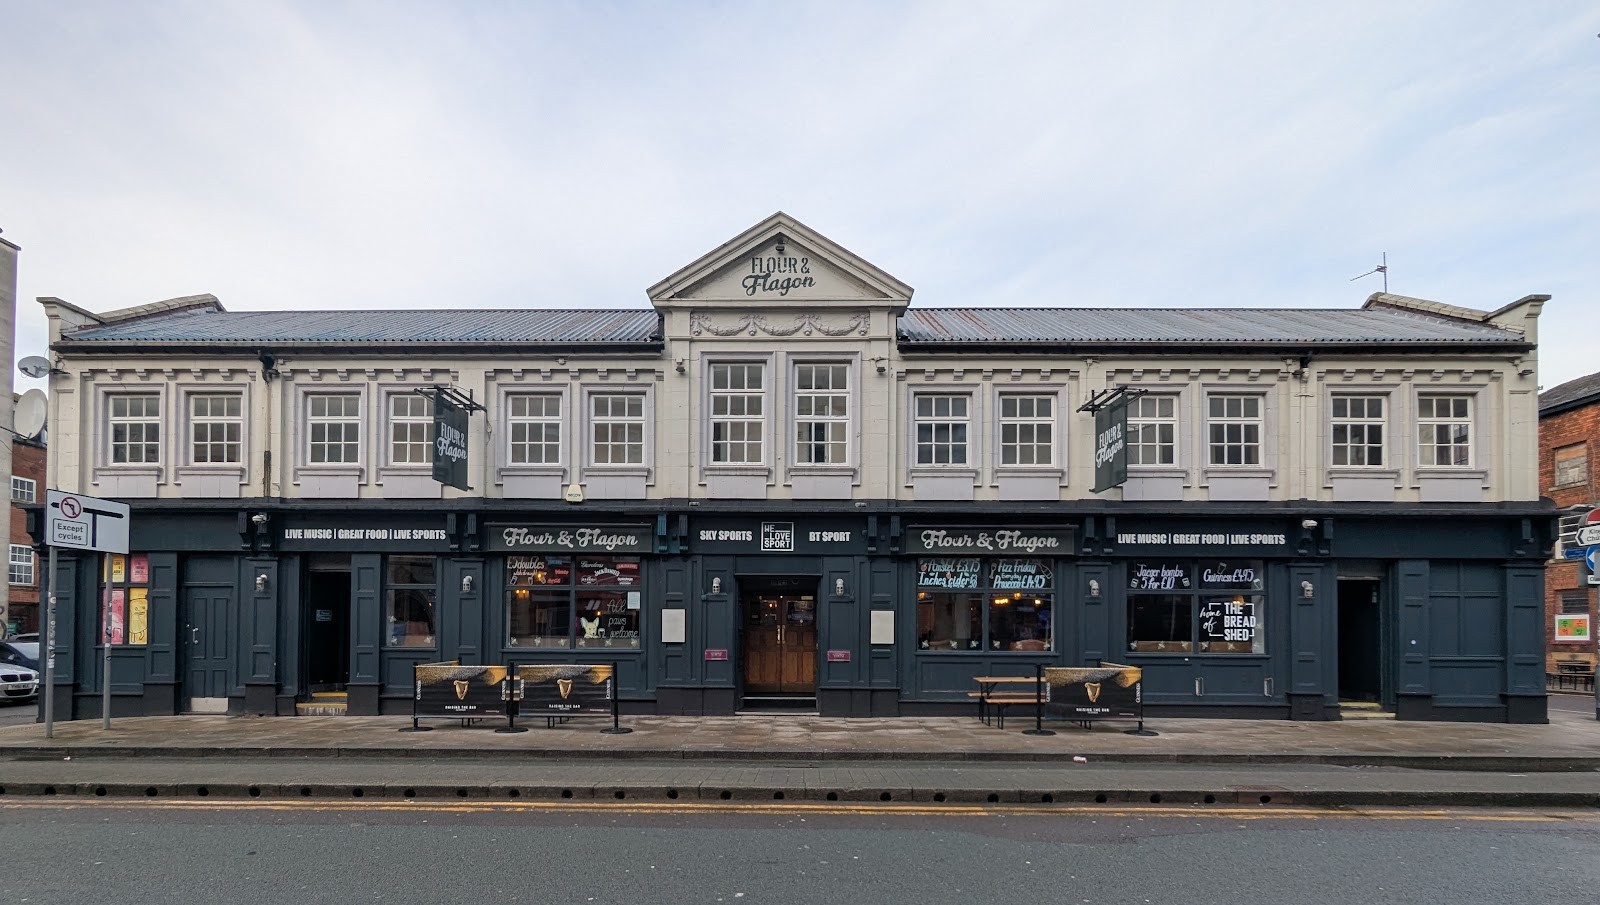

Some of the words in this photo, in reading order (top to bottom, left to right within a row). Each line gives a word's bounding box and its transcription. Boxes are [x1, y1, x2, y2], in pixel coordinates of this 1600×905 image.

[751, 257, 797, 273] FLOUR
[800, 257, 810, 274] &
[742, 272, 816, 296] Flagon
[441, 422, 461, 446] FLOUR
[460, 432, 465, 448] &
[1099, 425, 1117, 449] FLOUR
[1116, 422, 1122, 439] &
[437, 436, 467, 462] Flagon
[1096, 439, 1123, 468] Flagon
[57, 523, 83, 533] Except
[285, 529, 302, 539] LIVE
[304, 529, 332, 539] MUSIC
[338, 529, 364, 539] GREAT
[365, 530, 387, 539] FOOD
[394, 530, 411, 539] LIVE
[413, 530, 446, 540] SPORTS
[764, 524, 775, 533] WE
[58, 532, 82, 541] cycles
[503, 528, 555, 547] Flour
[557, 530, 574, 548] &
[575, 528, 638, 551] Flagon
[700, 530, 717, 541] SKY
[718, 530, 753, 541] SPORTS
[769, 532, 790, 540] LOVE
[809, 531, 821, 541] BT
[822, 531, 851, 542] SPORT
[920, 529, 974, 549] Flour
[976, 532, 994, 550] &
[995, 530, 1060, 552] Flagon
[1117, 533, 1137, 544] LIVE
[1138, 533, 1167, 544] MUSIC
[1173, 534, 1200, 544] GREAT
[1201, 534, 1225, 545] FOOD
[1231, 534, 1249, 545] LIVE
[1250, 534, 1286, 545] SPORTS
[764, 540, 790, 548] SPORT
[518, 556, 545, 569] doubles
[927, 559, 956, 572] Amstel
[997, 559, 1012, 572] Fizz
[1013, 559, 1037, 574] Friday
[1136, 563, 1160, 577] Jaeger
[1161, 563, 1184, 577] bombs
[1203, 568, 1232, 582] Guinness
[918, 571, 946, 586] Inches
[947, 572, 970, 586] cider
[1140, 577, 1148, 589] 5
[1148, 577, 1160, 589] for
[1160, 577, 1175, 589] £10
[606, 599, 626, 613] All
[1199, 607, 1221, 618] home
[1224, 602, 1244, 615] THE
[608, 617, 627, 627] paws
[1202, 617, 1217, 633] of
[1224, 615, 1256, 628] BREAD
[610, 626, 638, 638] welcome
[1224, 628, 1249, 641] SHED
